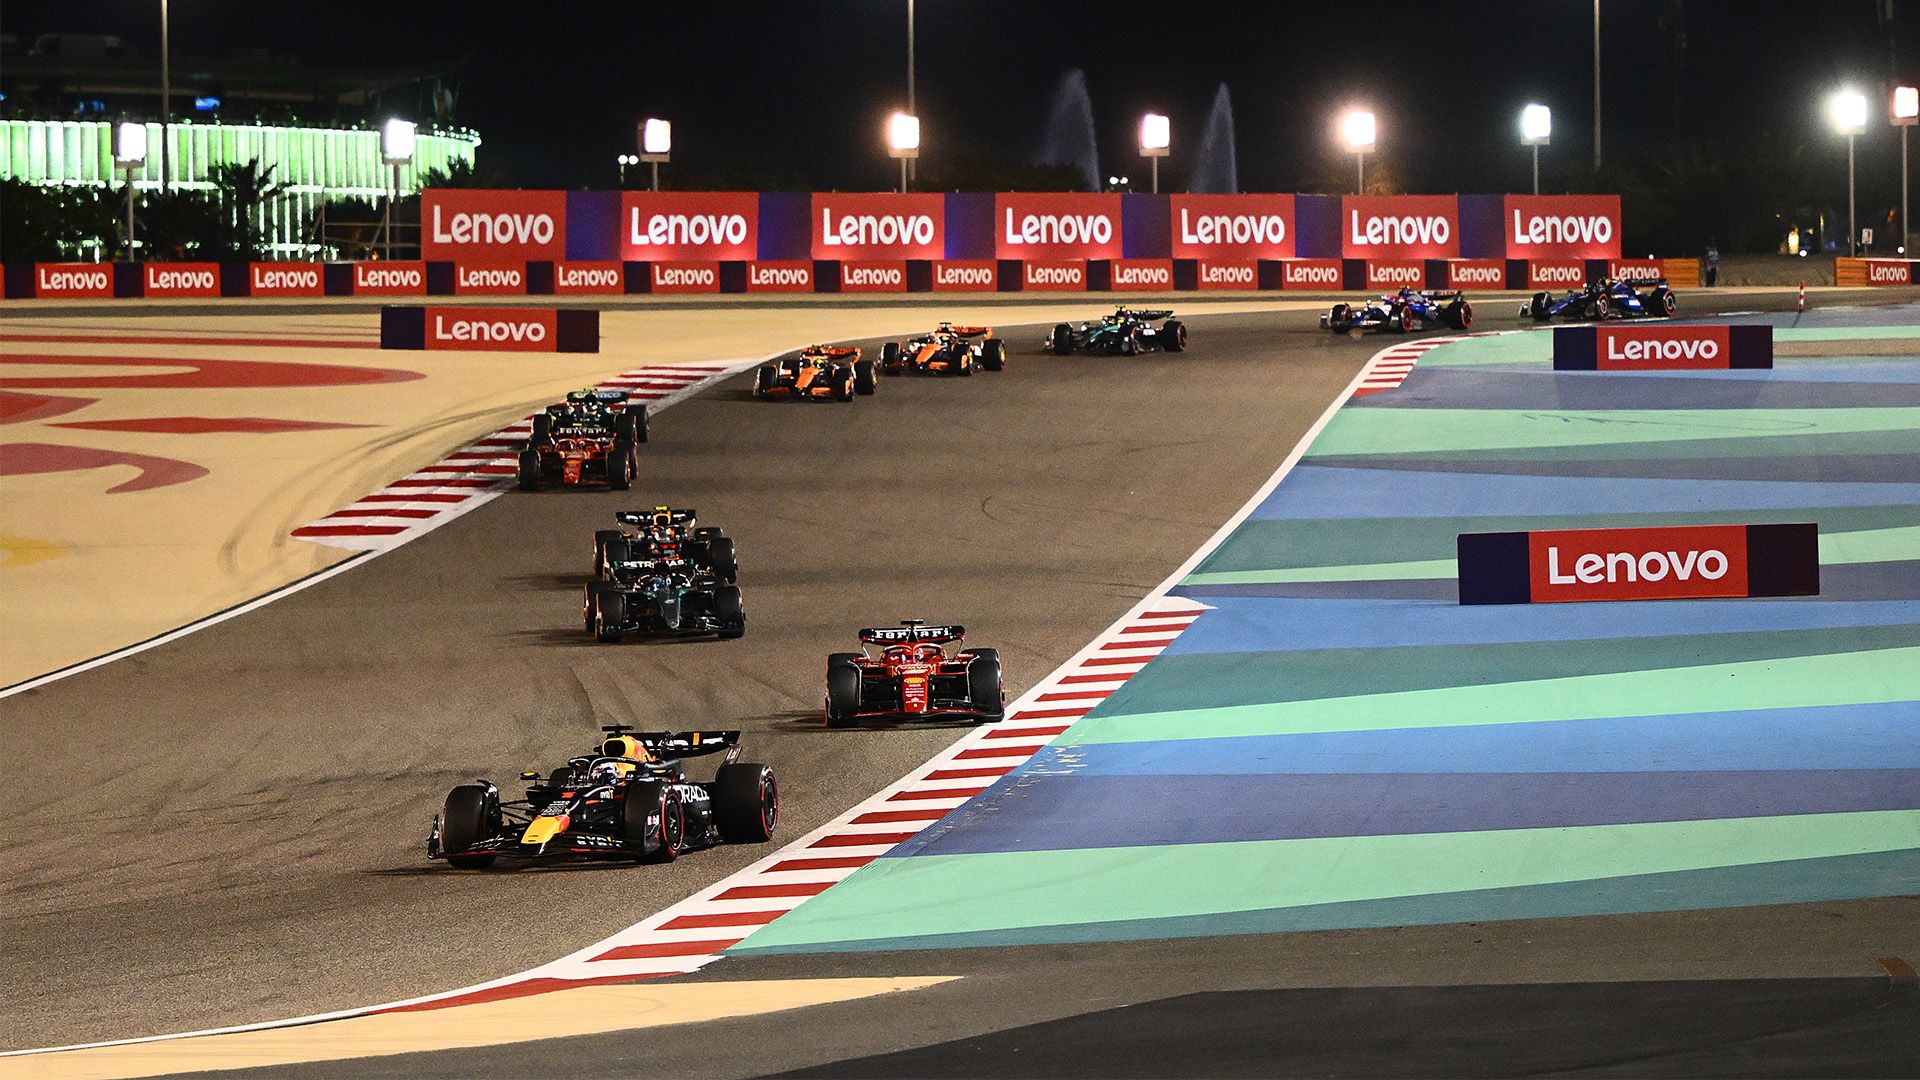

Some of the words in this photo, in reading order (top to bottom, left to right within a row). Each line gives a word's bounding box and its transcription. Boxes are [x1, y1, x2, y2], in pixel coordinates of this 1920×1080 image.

[434, 205, 553, 244] Lenovo
[632, 207, 746, 245] Lenovo
[824, 208, 934, 245] Lenovo
[1006, 208, 1111, 244] Lenovo
[1182, 208, 1285, 244] Lenovo
[1352, 210, 1449, 244] Lenovo
[1515, 209, 1611, 244] Lenovo
[41, 268, 107, 289] Lenovo
[150, 268, 214, 288] Lenovo
[255, 268, 317, 288] Lenovo
[358, 267, 420, 286] Lenovo
[460, 267, 520, 286] Lenovo
[559, 266, 618, 286] Lenovo
[655, 265, 714, 285] Lenovo
[752, 265, 808, 284] Lenovo
[844, 265, 901, 284] Lenovo
[938, 265, 992, 284] Lenovo
[1028, 265, 1081, 283] Lenovo
[1115, 265, 1168, 283] Lenovo
[1202, 264, 1253, 282] Lenovo
[1287, 264, 1338, 282] Lenovo
[1370, 264, 1420, 282] Lenovo
[1451, 264, 1501, 282] Lenovo
[1533, 264, 1581, 281] Lenovo
[1612, 264, 1659, 279] Lenovo
[1871, 264, 1907, 281] Lenovo
[436, 318, 545, 341] Lenovo
[1608, 336, 1718, 359] Lenovo
[1549, 547, 1728, 584] Lenovo
[874, 629, 949, 639] Ferari
